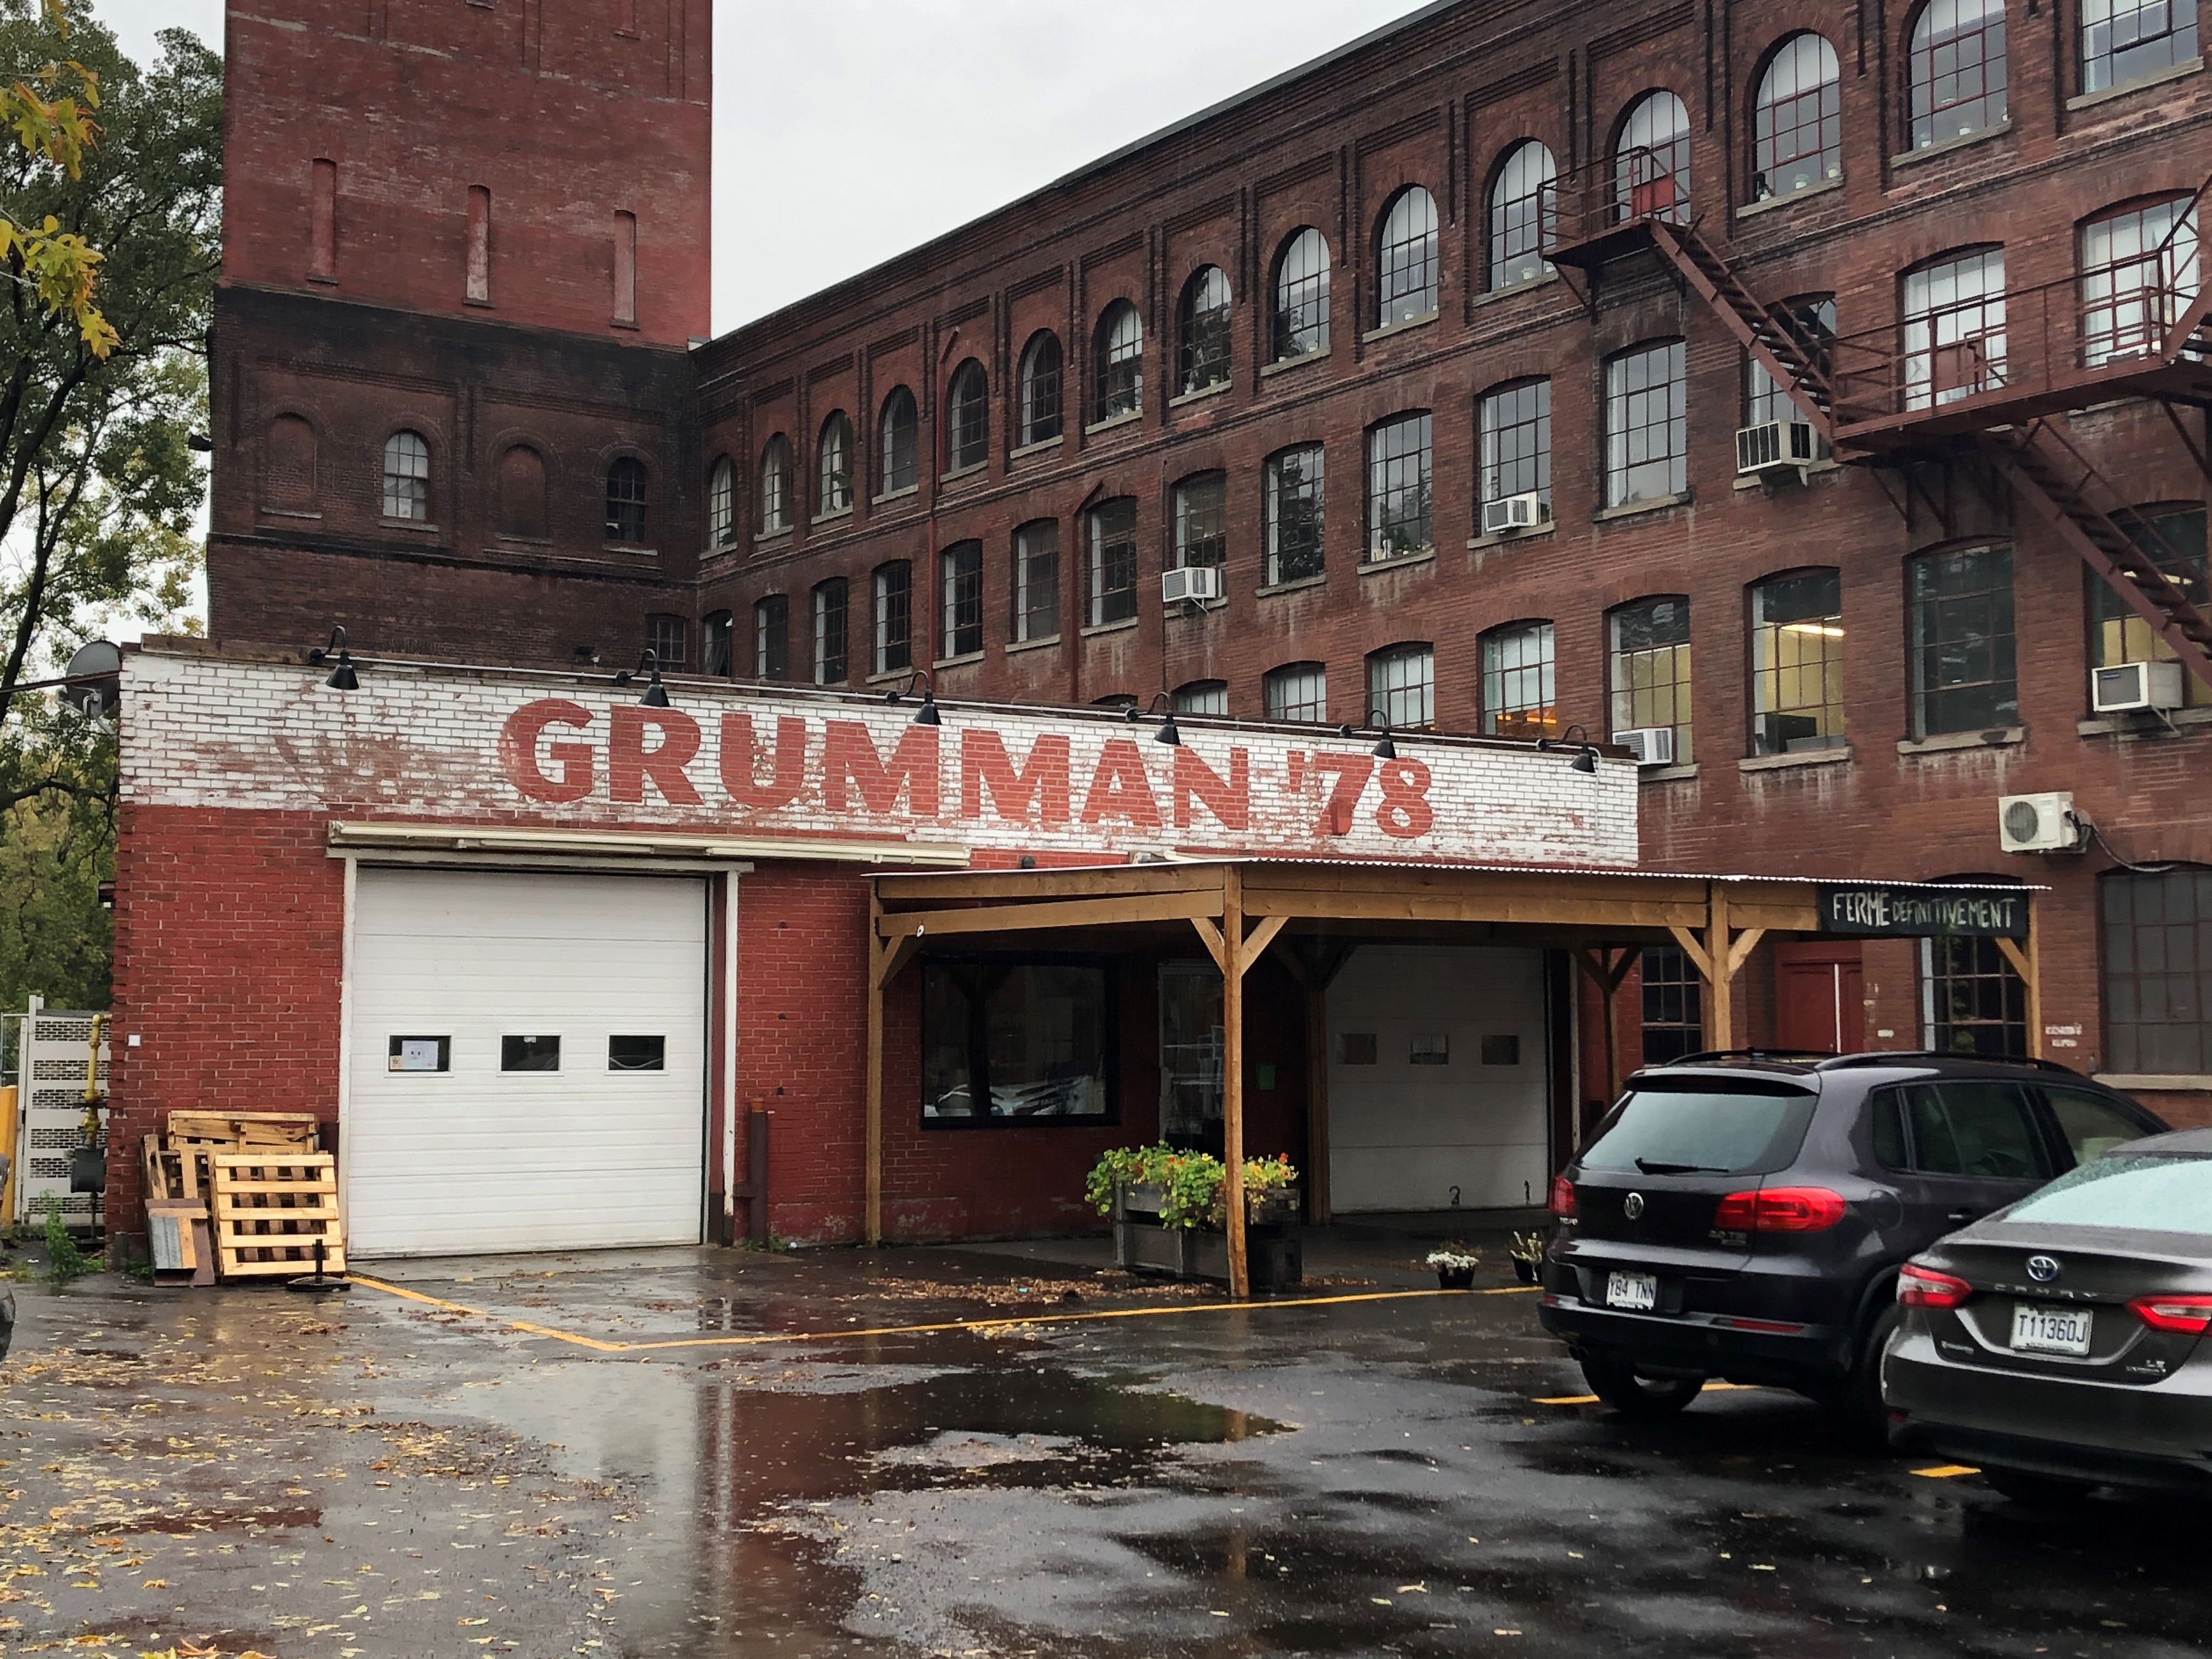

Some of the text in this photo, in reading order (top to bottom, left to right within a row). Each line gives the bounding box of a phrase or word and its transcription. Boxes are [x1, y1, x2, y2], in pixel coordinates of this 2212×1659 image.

[498, 697, 1434, 839] GRUMMAN '78
[1833, 887, 2017, 928] FERMÉ DÉFINITIVEMENT
[2019, 1314, 2087, 1342] T11360J
